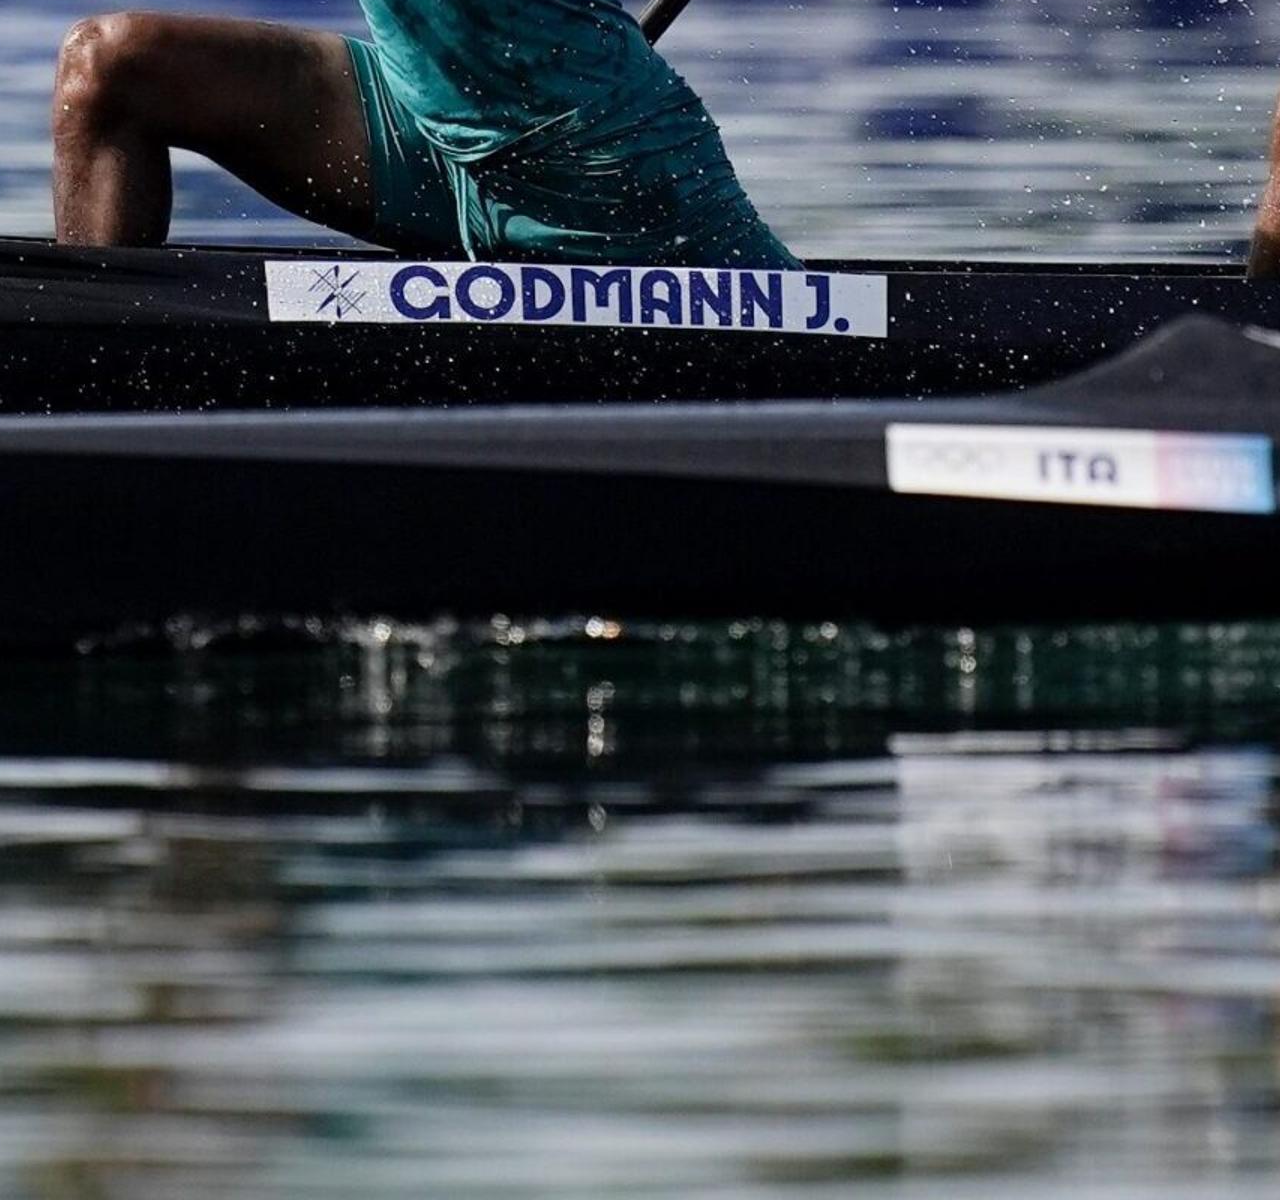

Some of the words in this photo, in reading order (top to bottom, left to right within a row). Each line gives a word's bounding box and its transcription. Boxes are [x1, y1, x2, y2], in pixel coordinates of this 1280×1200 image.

[389, 265, 783, 329] GODMANN
[806, 274, 850, 333] J.
[1036, 451, 1119, 485] ITA
